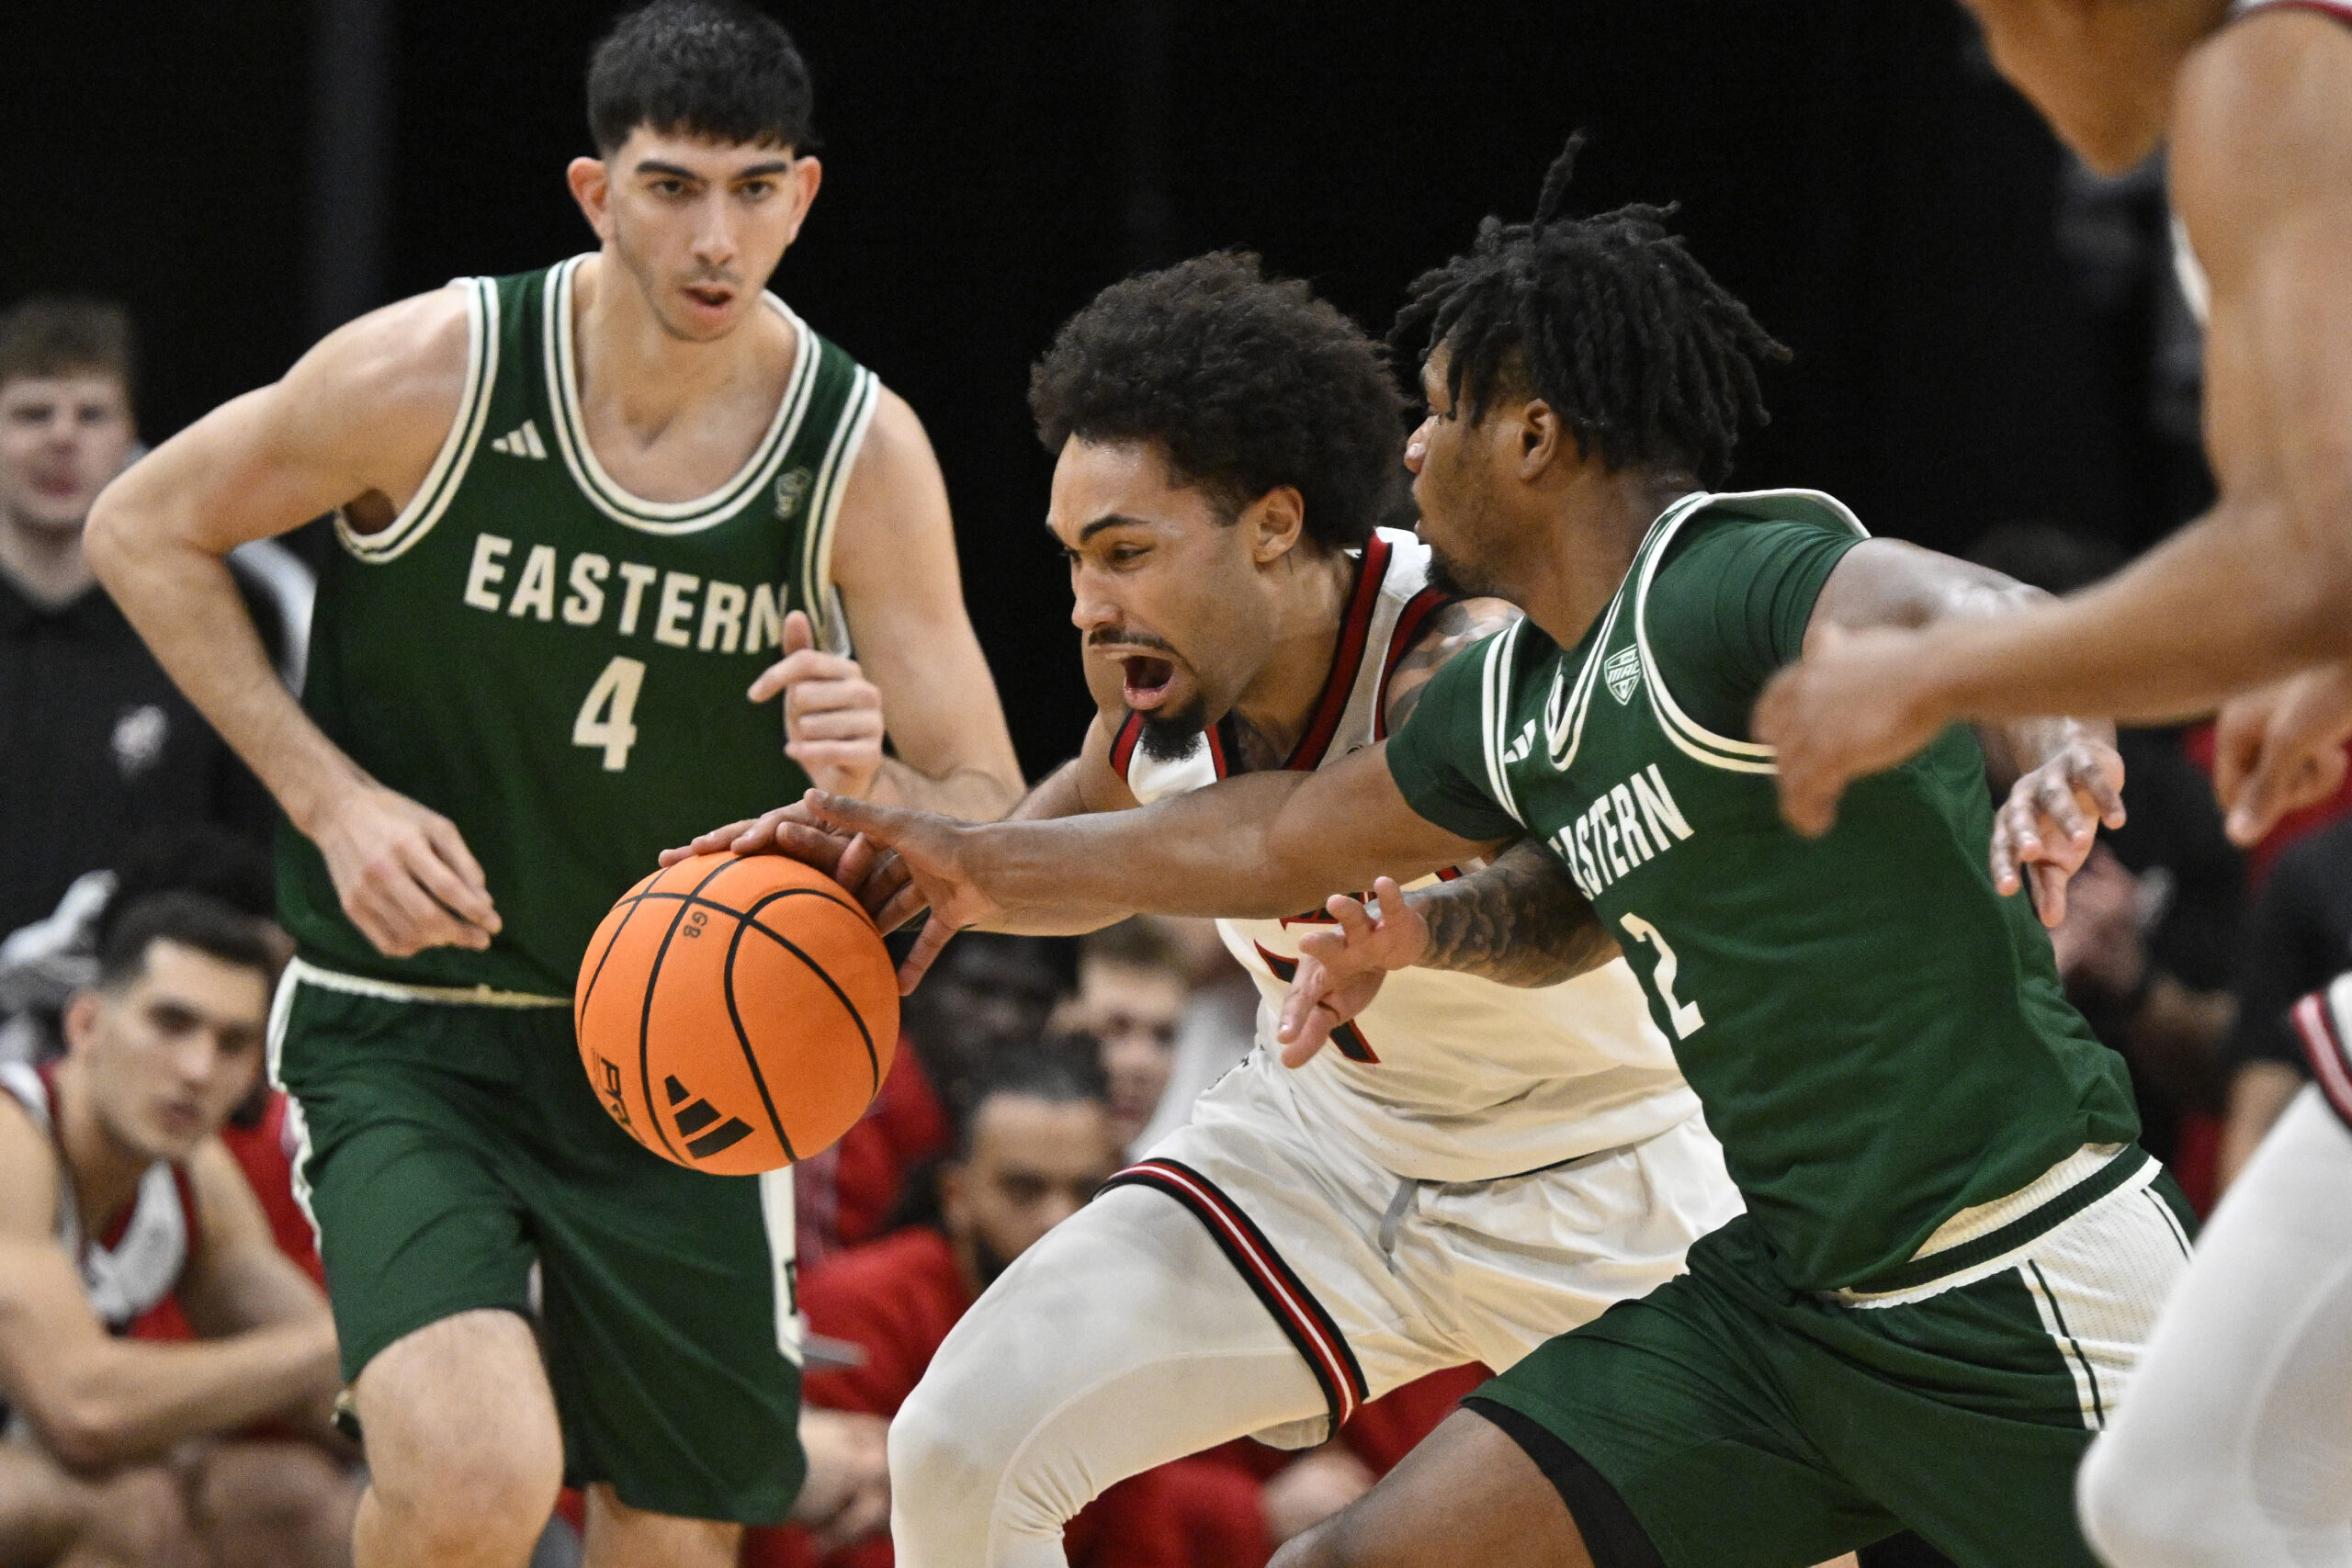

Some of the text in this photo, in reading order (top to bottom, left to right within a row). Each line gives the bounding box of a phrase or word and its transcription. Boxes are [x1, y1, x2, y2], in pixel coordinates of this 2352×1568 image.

[464, 533, 788, 654] EASTERN
[571, 655, 647, 773] 4
[1620, 912, 1706, 1041] 2
